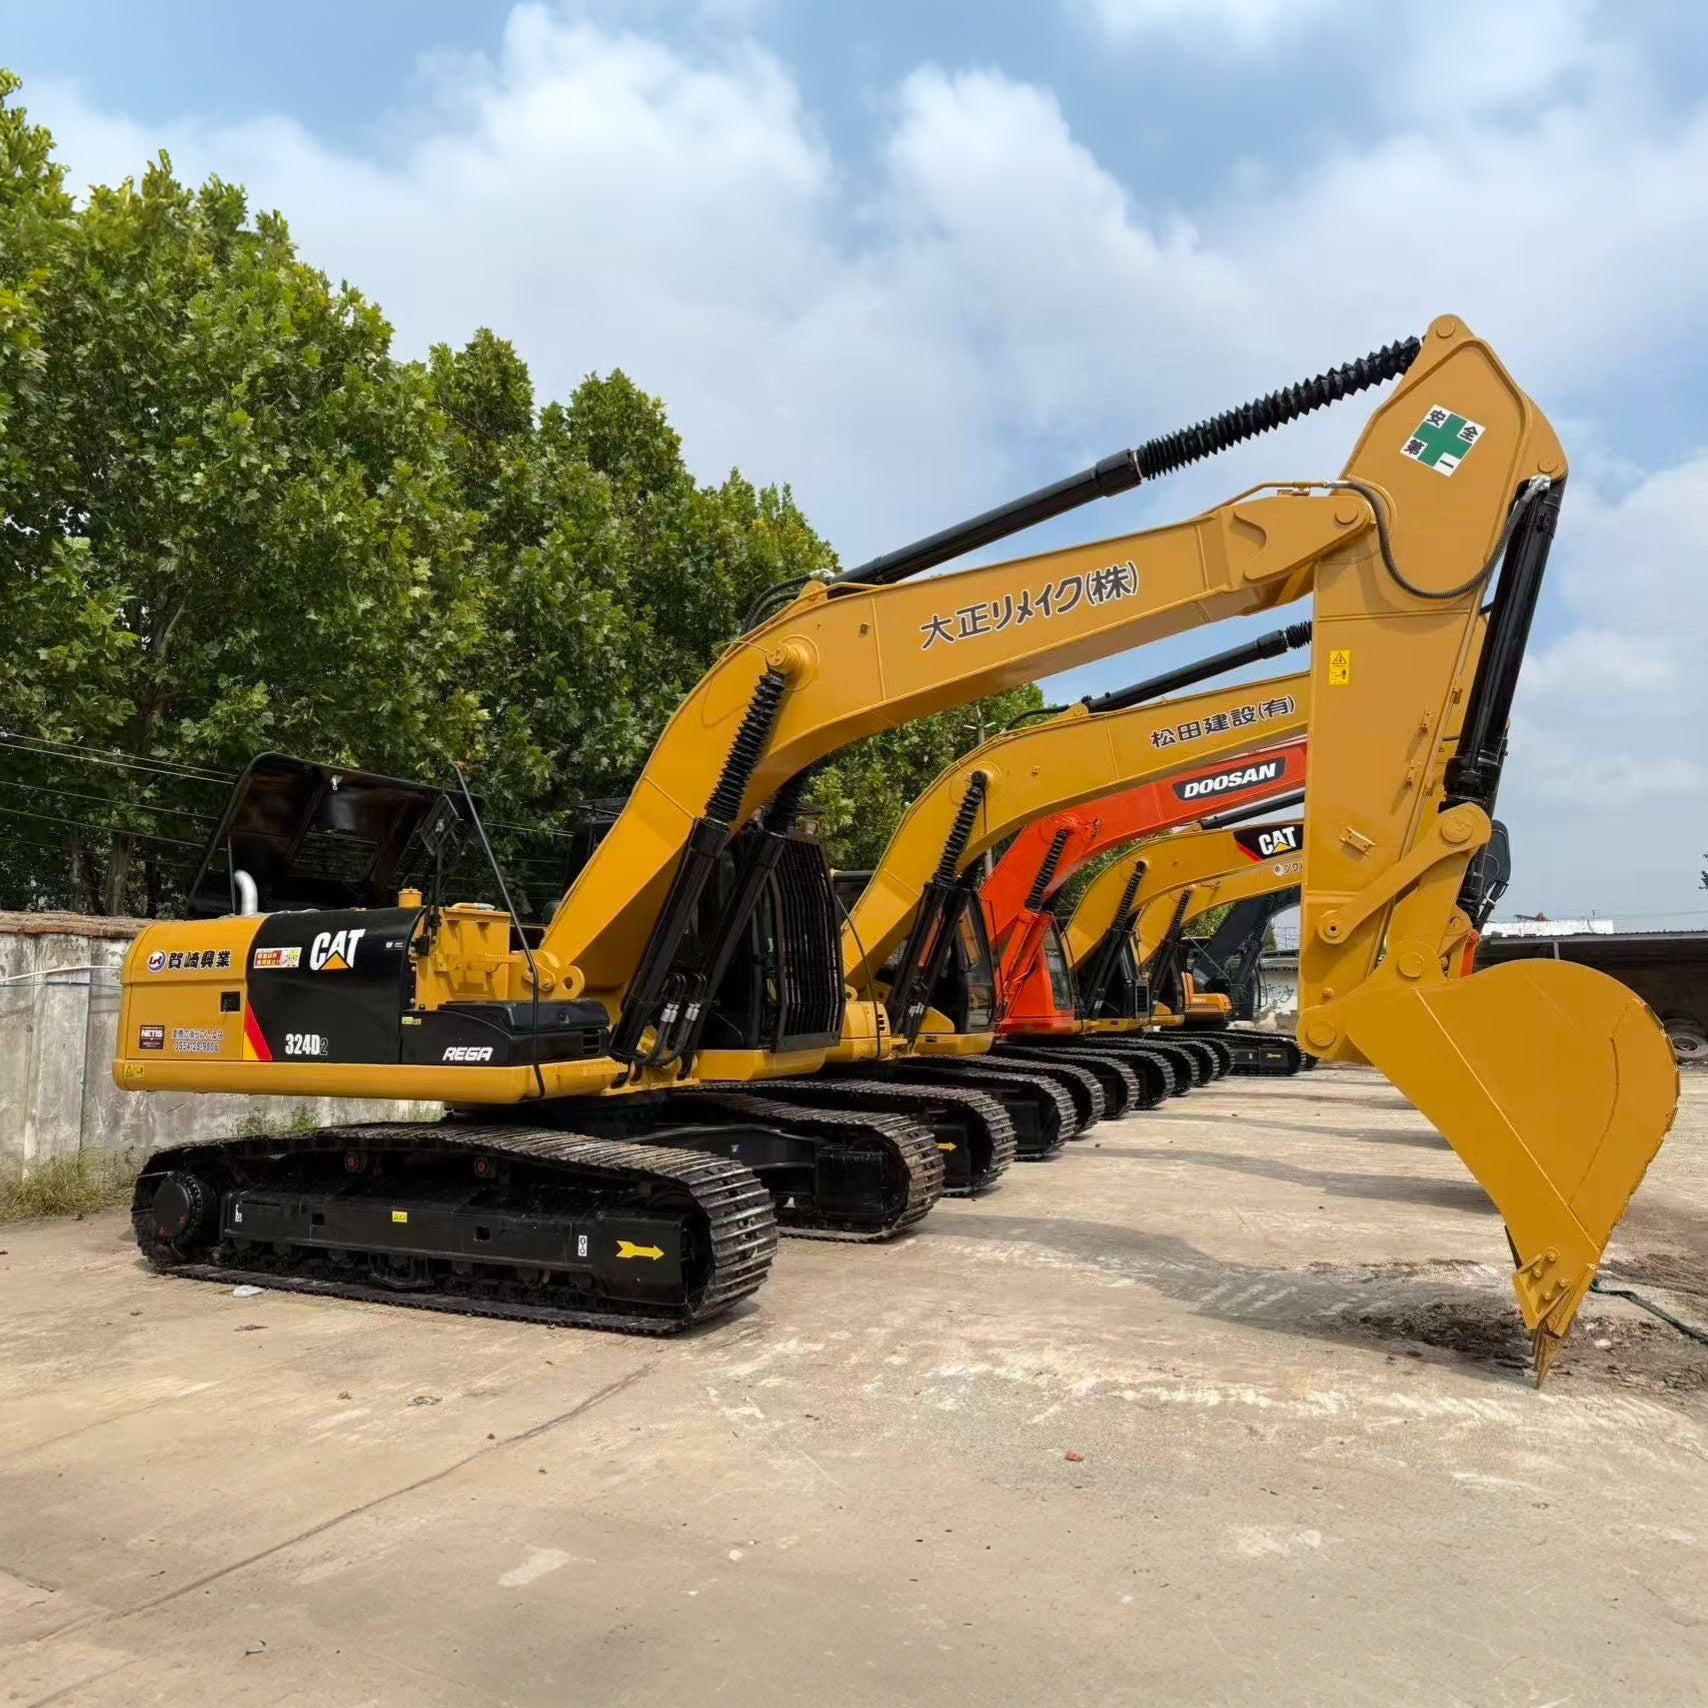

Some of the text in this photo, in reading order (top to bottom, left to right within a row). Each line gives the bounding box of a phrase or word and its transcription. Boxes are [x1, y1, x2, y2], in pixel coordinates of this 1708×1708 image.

[919, 560, 1139, 650] 大正リメイク(株)
[1150, 695, 1295, 749] 松田建設(有)
[1184, 762, 1277, 799] DOOSAN
[1258, 826, 1297, 856] CAT
[309, 928, 366, 971] CAT
[141, 1029, 163, 1038] NETIS
[442, 1046, 494, 1062] REGA
